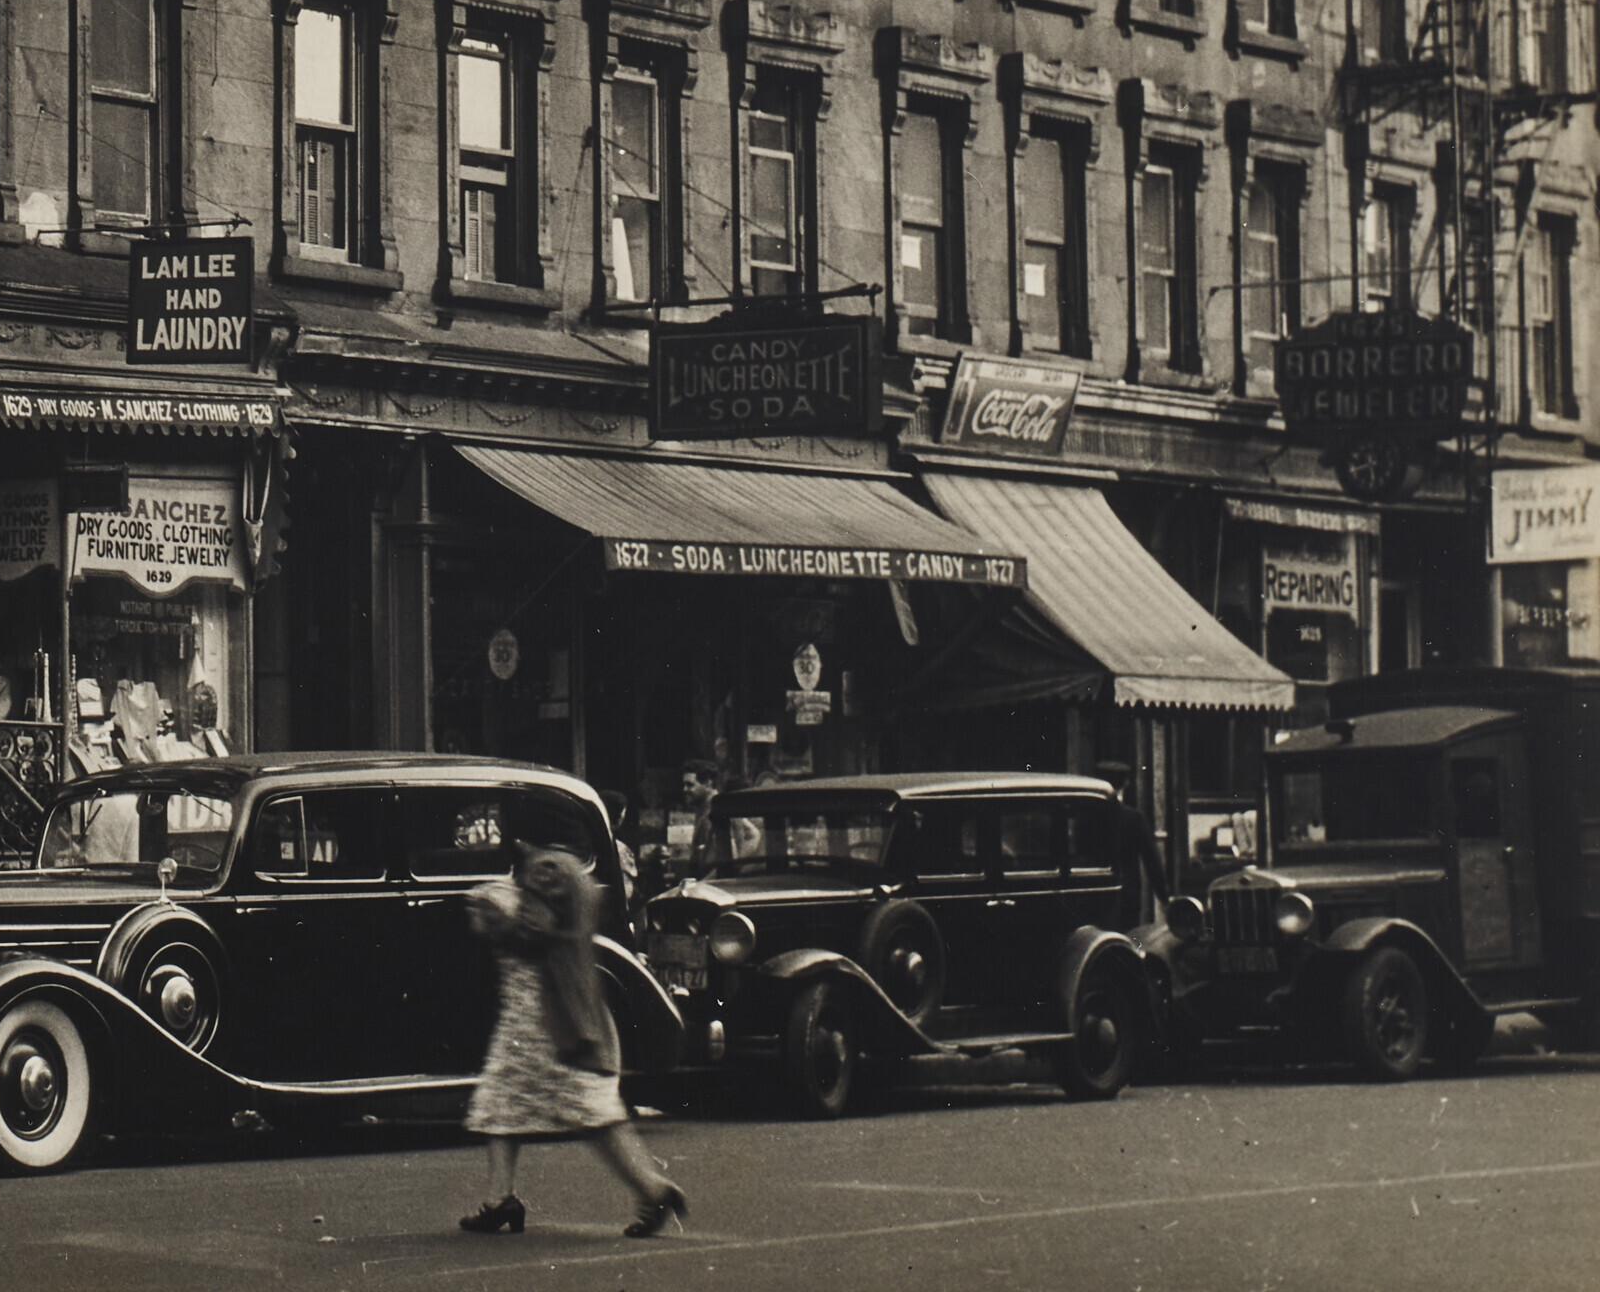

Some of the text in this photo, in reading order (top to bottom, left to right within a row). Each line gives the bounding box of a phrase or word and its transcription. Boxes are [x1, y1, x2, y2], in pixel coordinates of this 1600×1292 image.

[142, 254, 236, 279] LAM LEE
[166, 288, 222, 310] HAND
[137, 316, 247, 351] LAUNDRY
[711, 339, 806, 363] CANDY
[1284, 342, 1462, 381] BORRERO
[668, 344, 852, 408] LUNCHEONETTE
[3, 394, 32, 417] 1629
[37, 397, 59, 415] DRY
[61, 400, 97, 418] GOODS
[118, 400, 173, 422] SANCHEZ
[178, 402, 241, 424] CLOTHING
[247, 403, 273, 424] 1629
[709, 395, 815, 421] SODA
[78, 516, 235, 547] DRY GOODS CLOTHING
[1504, 487, 1593, 546] JIMMY
[87, 538, 230, 568] FURNITURE JEWELRY
[672, 545, 726, 571] SODA
[740, 547, 892, 577] LUNCHEONETTE
[906, 552, 964, 580] CANDY
[146, 570, 173, 584] 1629
[1265, 563, 1354, 606] REPAIRING
